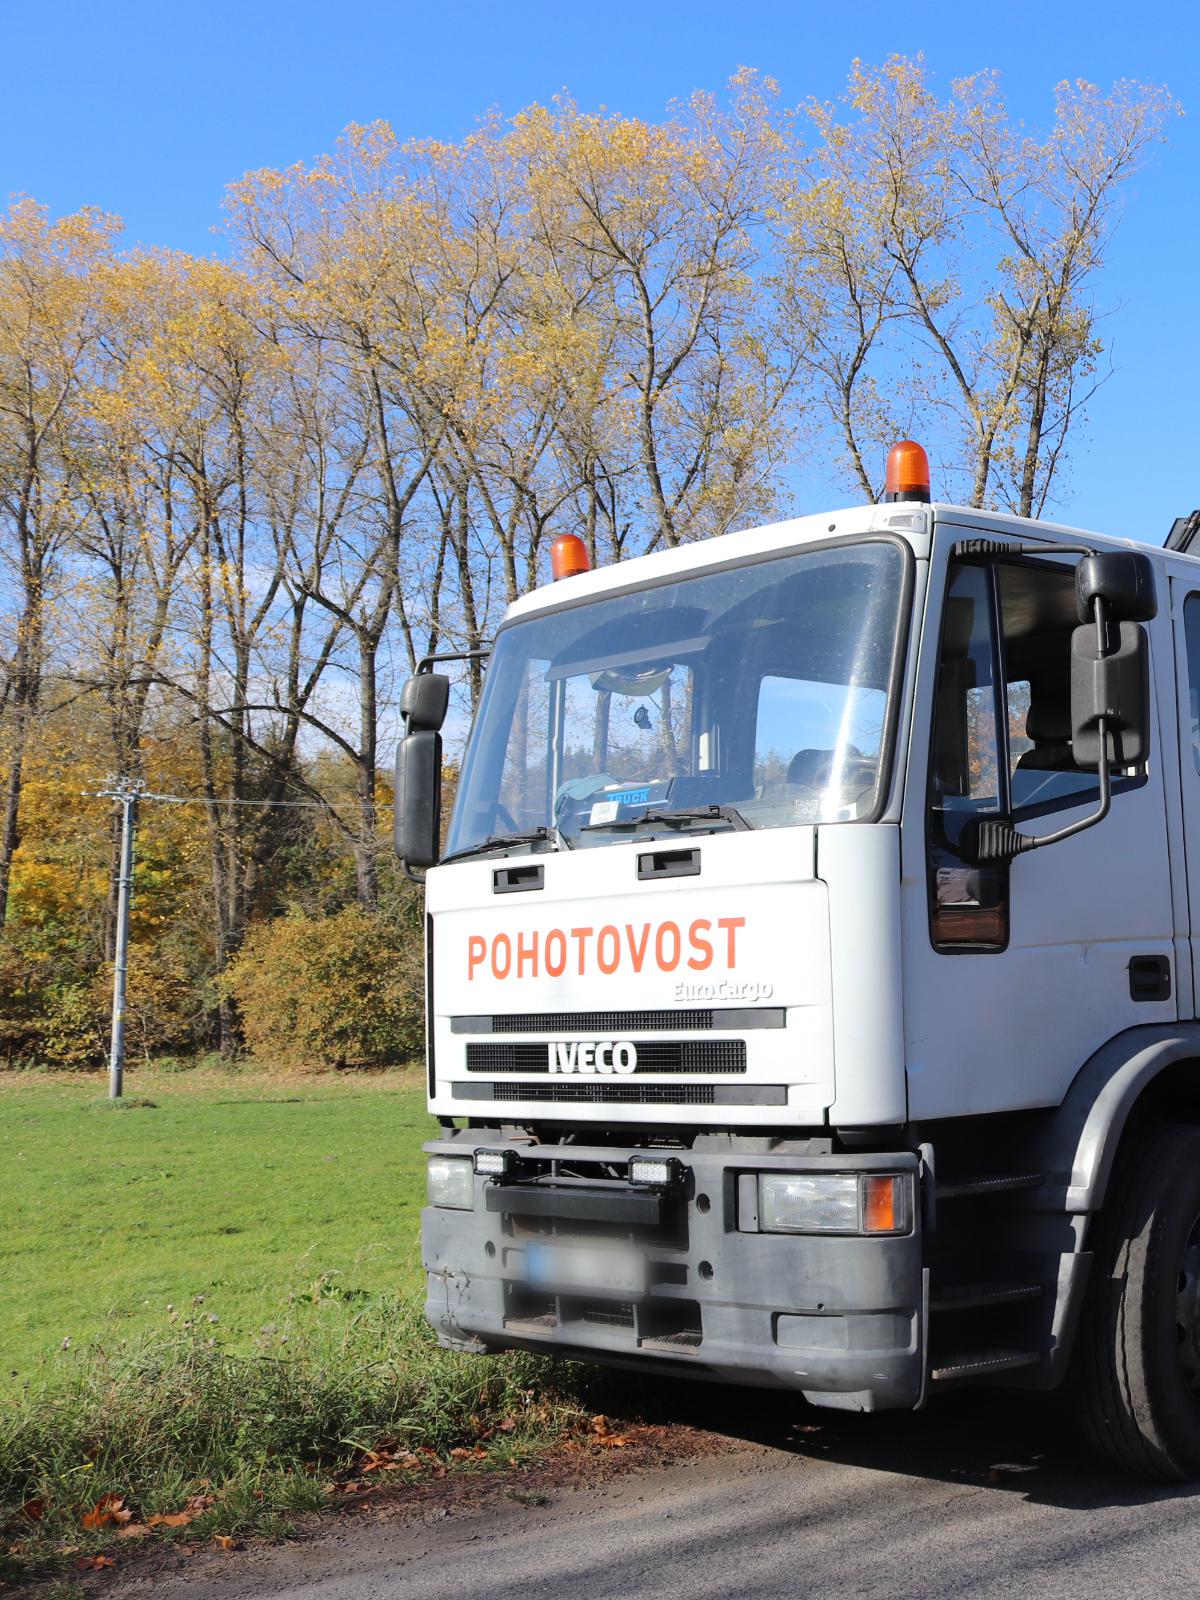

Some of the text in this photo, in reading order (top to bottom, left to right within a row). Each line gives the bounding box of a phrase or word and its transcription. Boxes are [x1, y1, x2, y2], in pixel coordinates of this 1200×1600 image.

[468, 917, 745, 981] POHOTOVOST
[673, 981, 774, 1002] EuroCargo
[547, 1041, 637, 1073] IVECO
